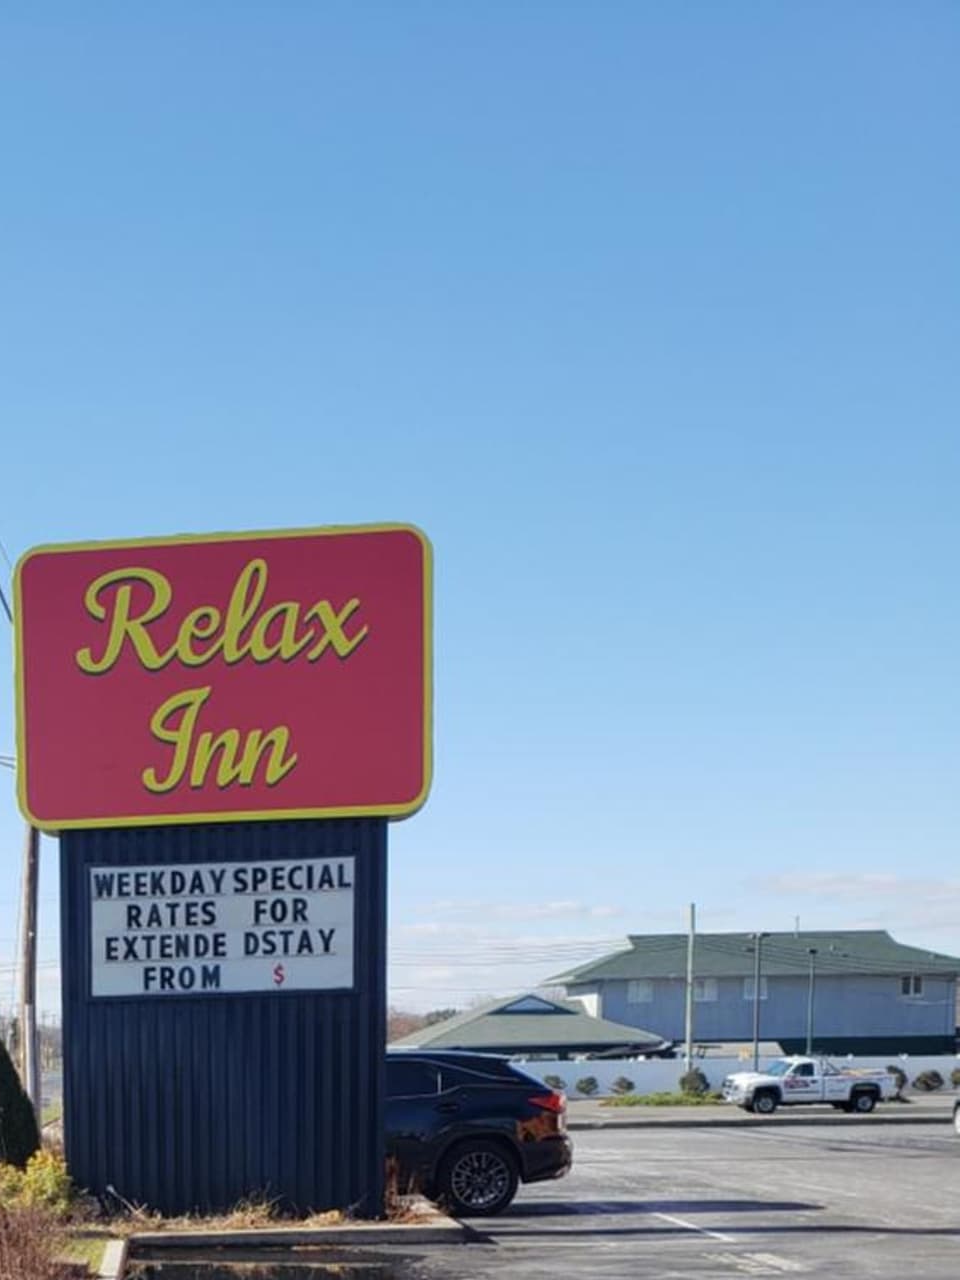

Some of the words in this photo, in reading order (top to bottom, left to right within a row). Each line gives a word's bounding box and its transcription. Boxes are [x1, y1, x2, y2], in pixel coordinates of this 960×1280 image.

[76, 558, 369, 675] Relax
[142, 686, 298, 793] Inn
[93, 868, 227, 898] WEEKDAY
[233, 863, 352, 894] SPECIAL
[126, 901, 217, 928] RATES
[253, 898, 310, 924] FOR
[105, 932, 228, 961] EXTENDE
[143, 964, 222, 991] FROM
[272, 963, 286, 987] $
